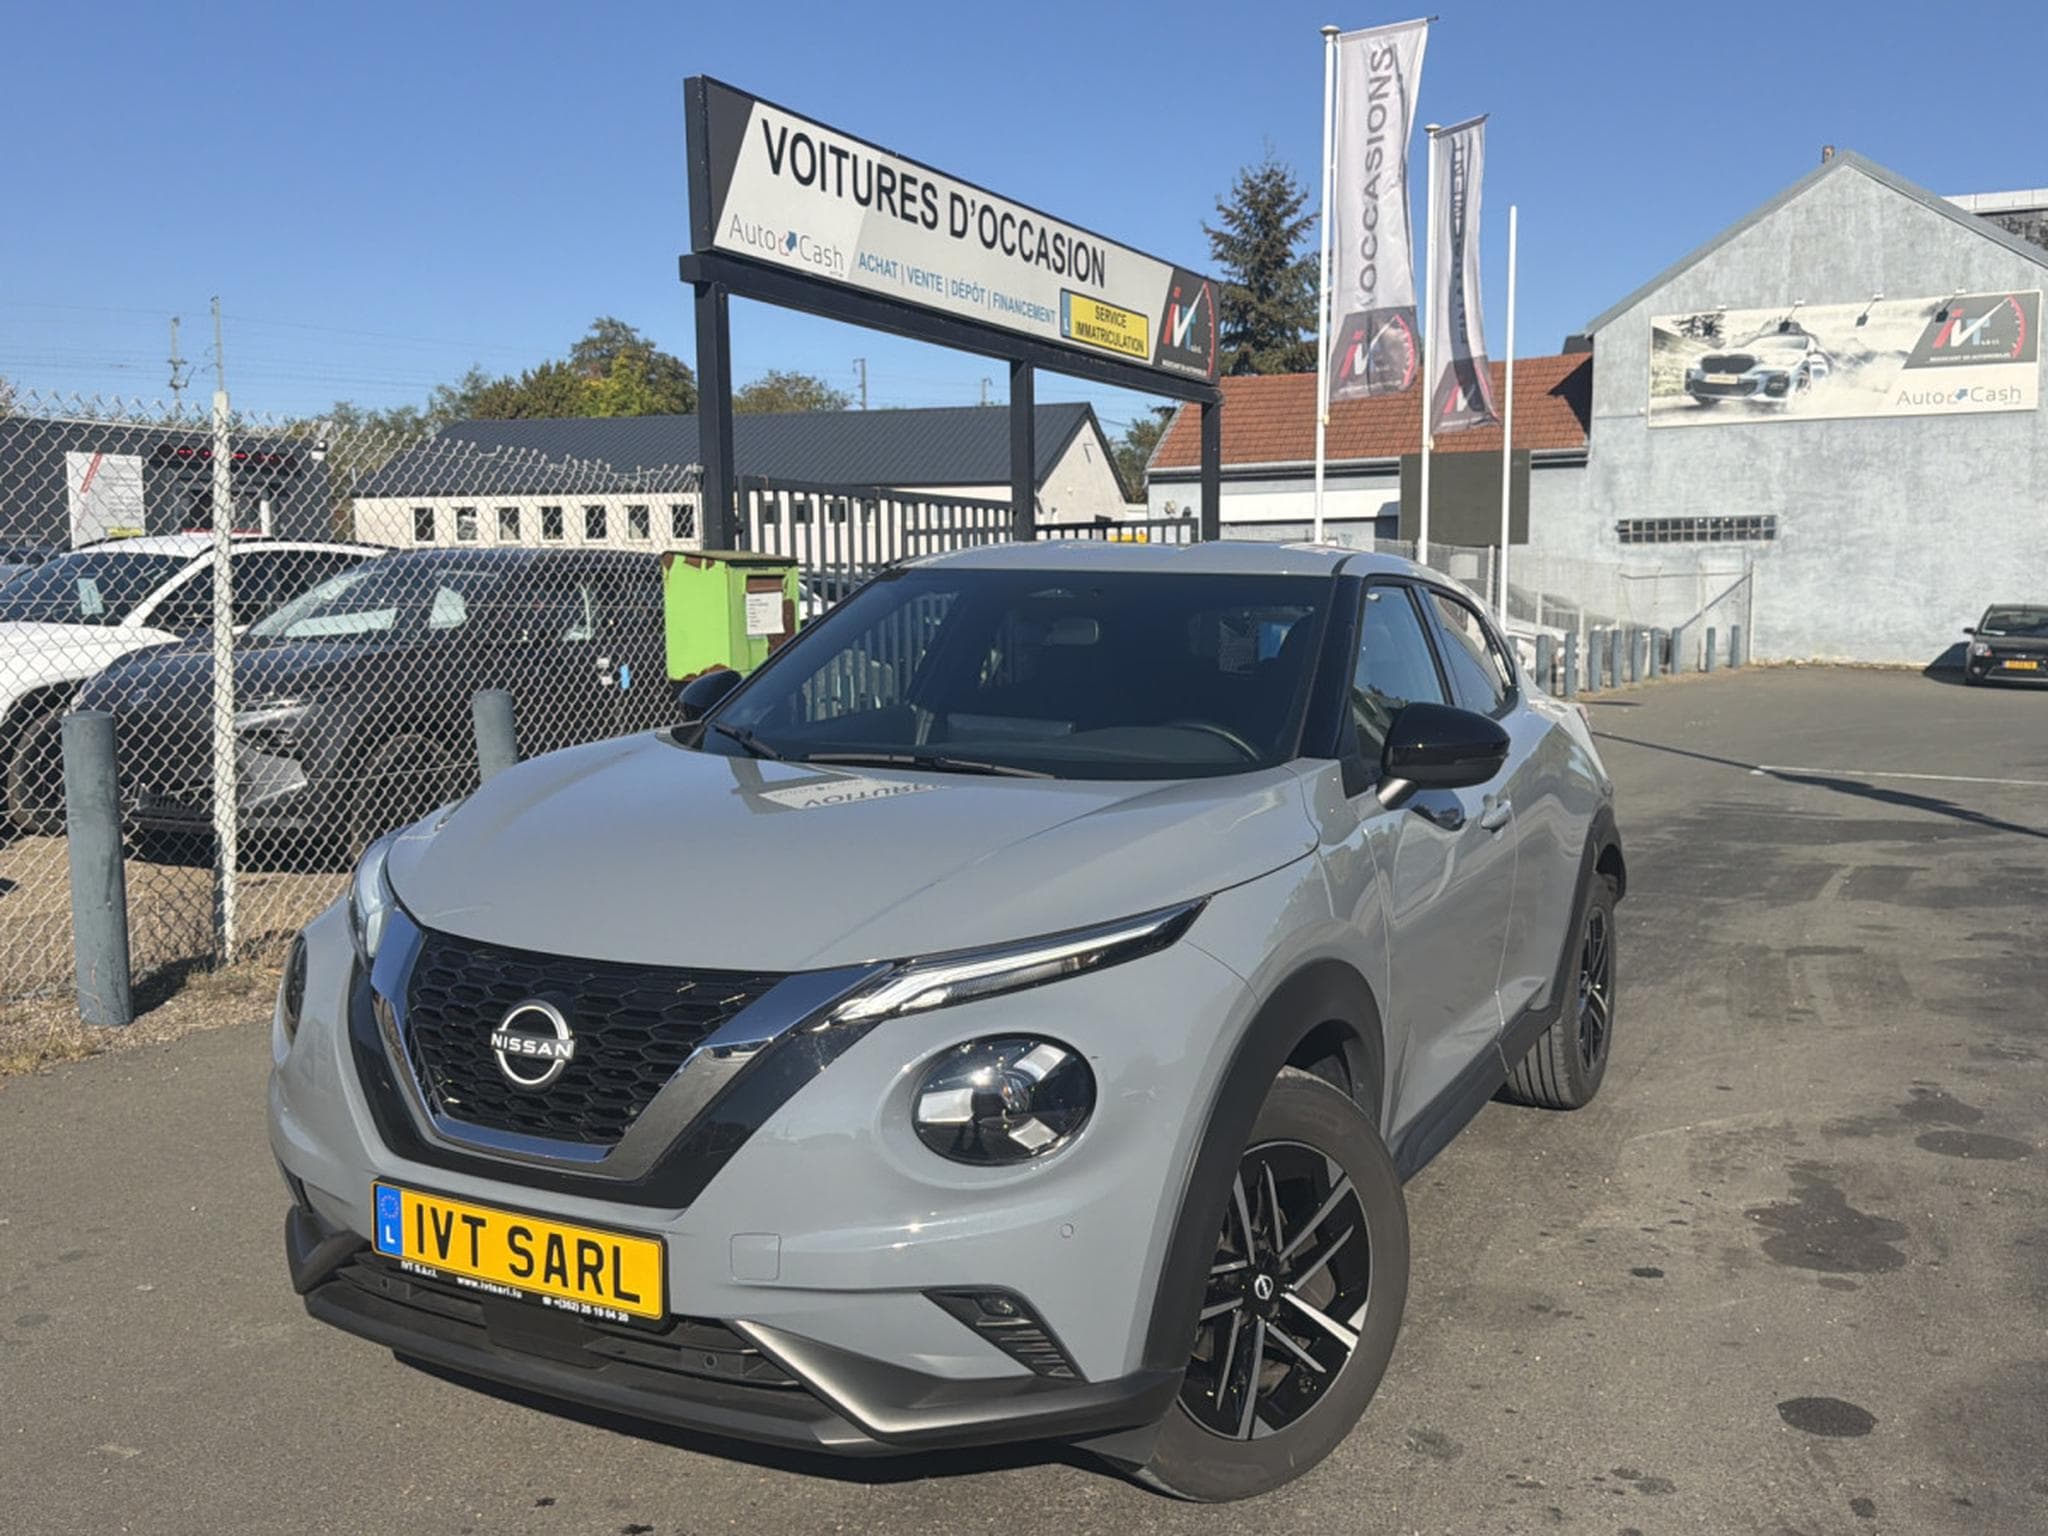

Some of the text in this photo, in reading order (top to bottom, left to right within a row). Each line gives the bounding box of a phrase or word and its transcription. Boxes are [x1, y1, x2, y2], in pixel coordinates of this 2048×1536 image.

[1359, 46, 1394, 292] OCCASIONS
[762, 118, 1105, 288] VOITURES D'OCCASION
[729, 213, 844, 271] Auto Cash
[858, 252, 1057, 324] ACHAT VENTE DÉPÔT FINANCEMENT
[1076, 321, 1144, 353] IMMATRICULATION
[1095, 305, 1127, 329] SERVICE
[1896, 384, 2022, 406] Auto Cash
[490, 1032, 571, 1057] NISSAN
[384, 1226, 395, 1244] L
[416, 1204, 641, 1304] IVT SARL
